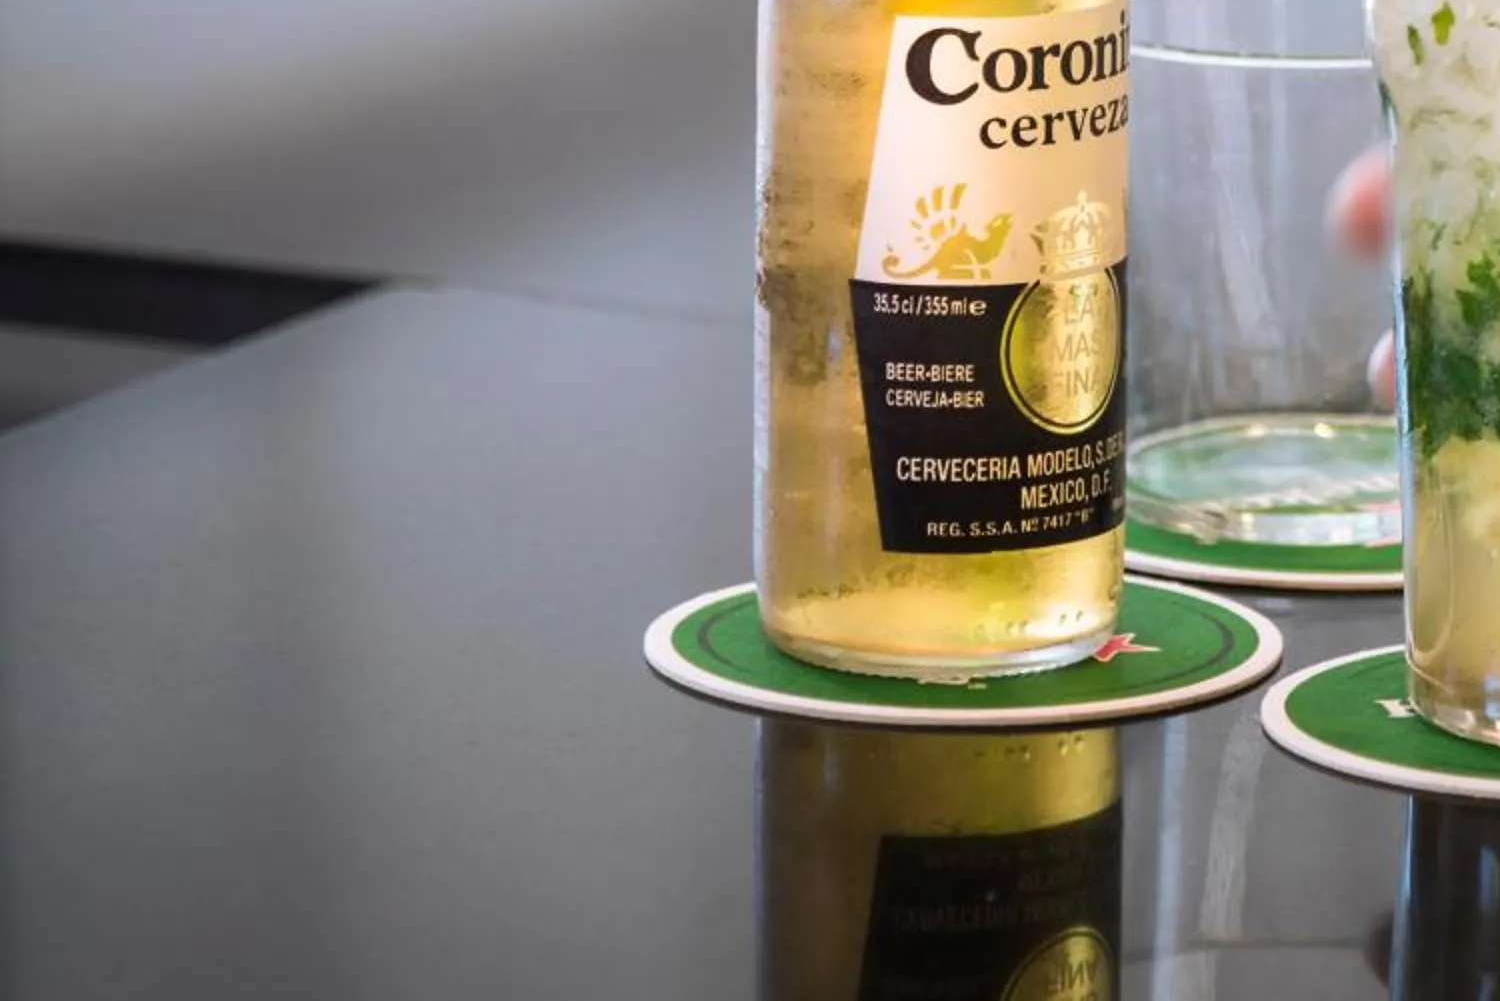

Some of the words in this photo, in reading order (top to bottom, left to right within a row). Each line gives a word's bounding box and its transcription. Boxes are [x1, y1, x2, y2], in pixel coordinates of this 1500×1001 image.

[905, 9, 1129, 106] Coroni
[896, 455, 1022, 482] CERVECERIA
[1021, 477, 1089, 510] MEXICO,
[927, 521, 965, 537] REG.
